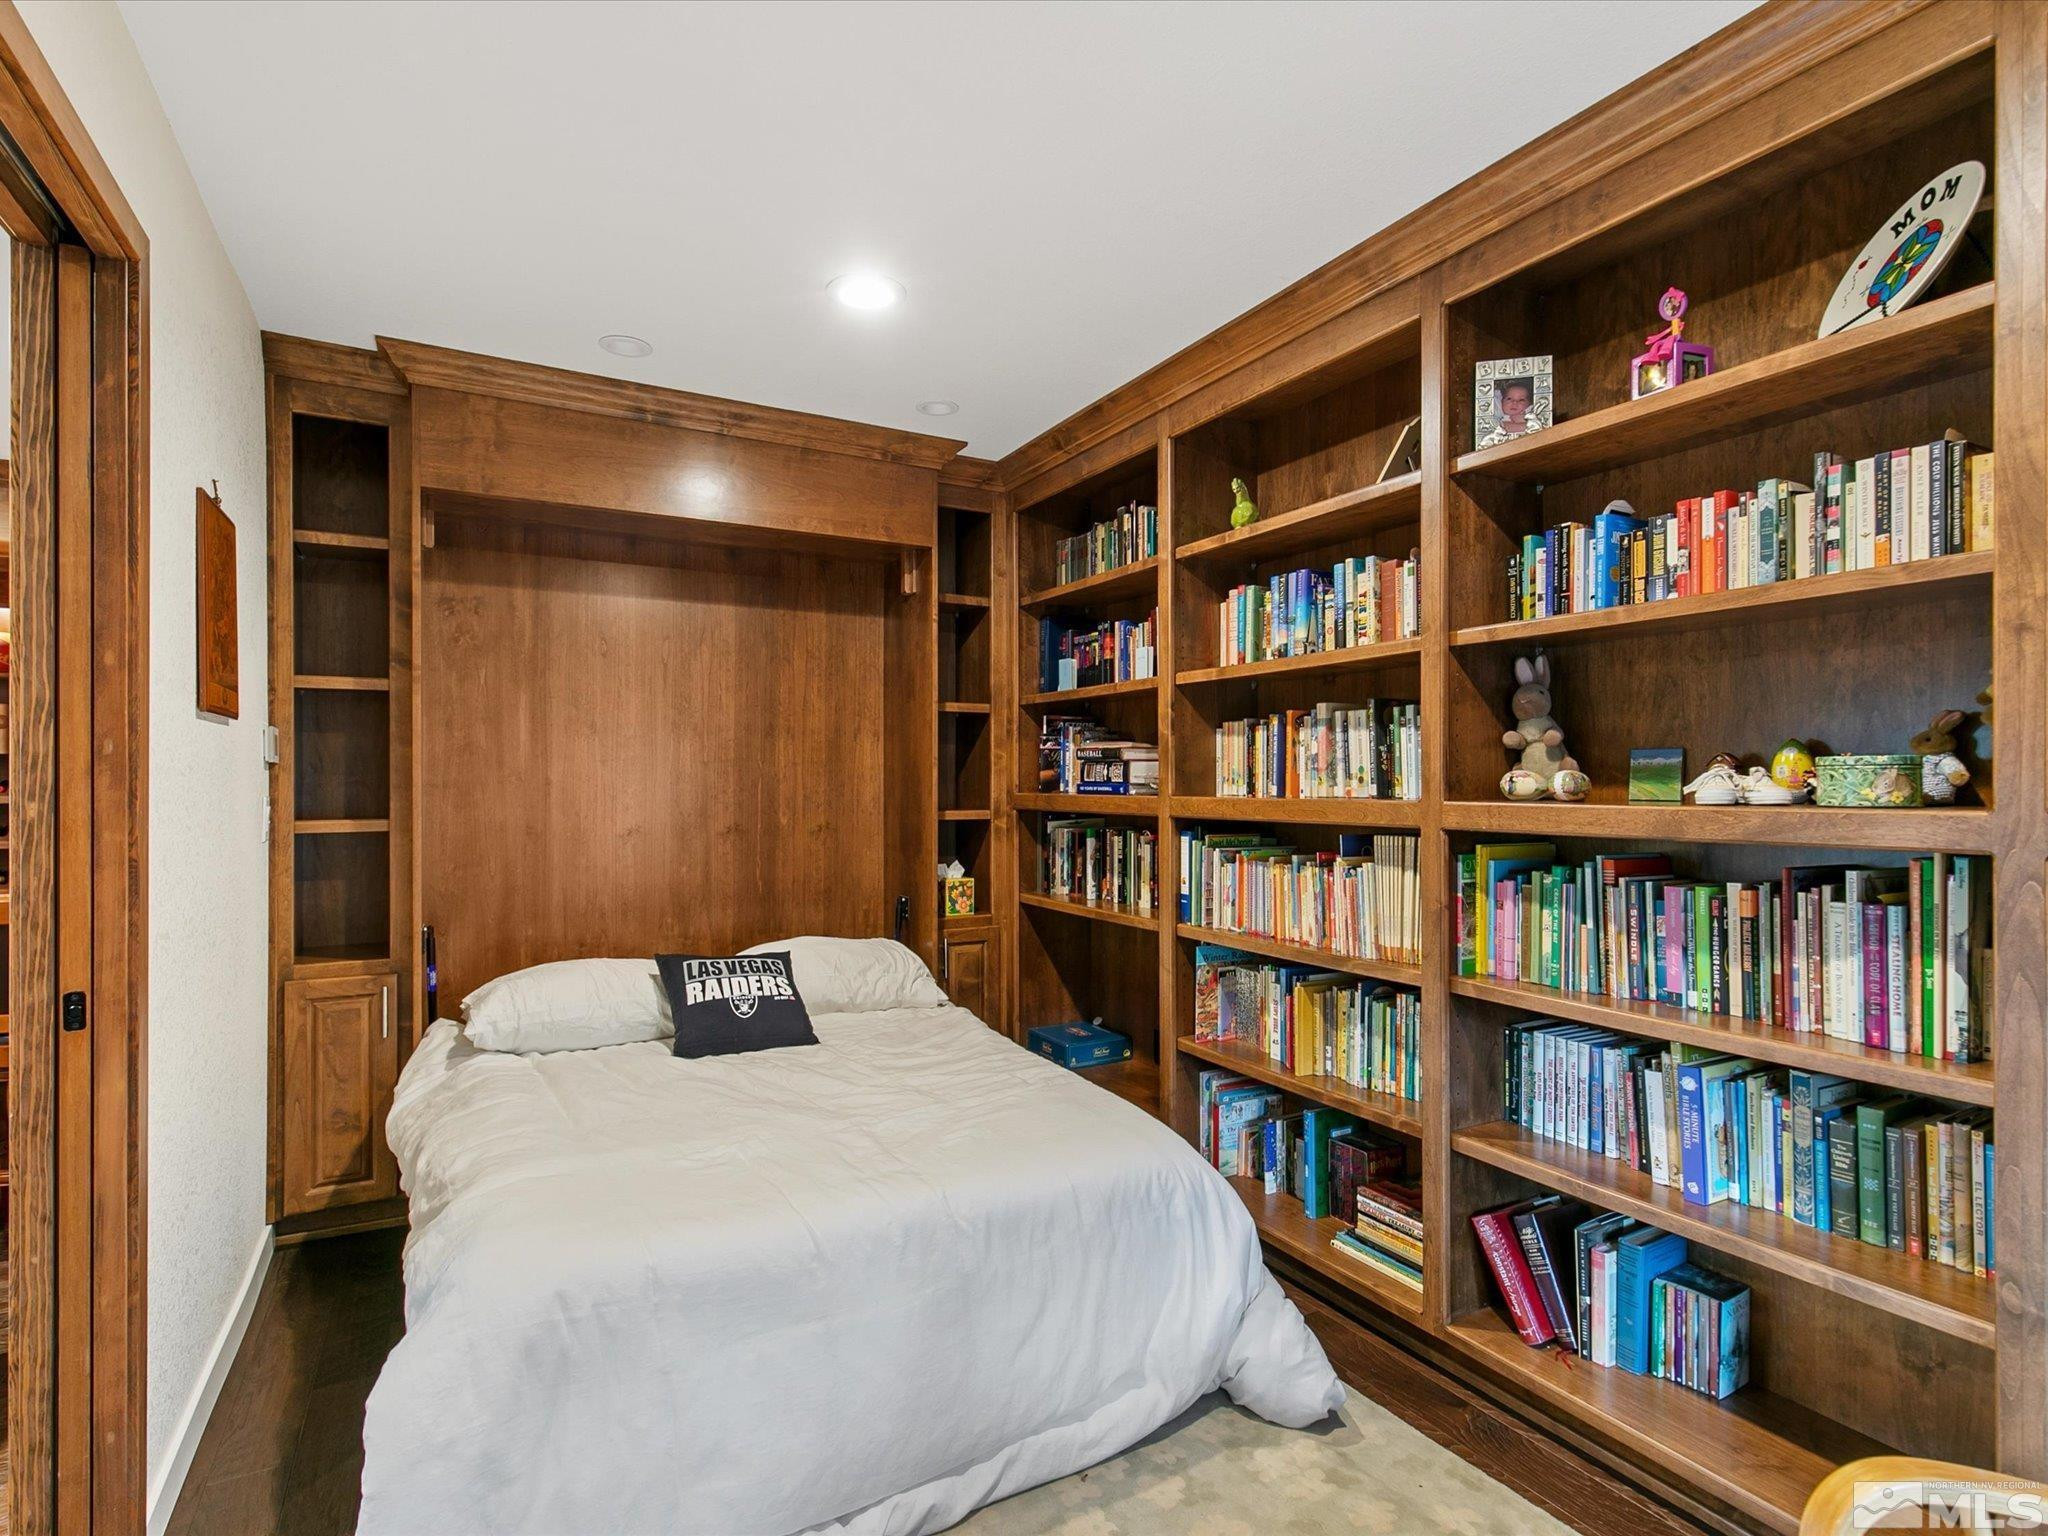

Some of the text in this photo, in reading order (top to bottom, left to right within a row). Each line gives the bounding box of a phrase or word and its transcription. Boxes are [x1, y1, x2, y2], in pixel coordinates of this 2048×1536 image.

[1890, 175, 1962, 239] MOM
[1479, 357, 1549, 377] BABY
[1932, 444, 1941, 556] THE COLD MILLIONS JESS WALTE
[1077, 749, 1103, 758] BASEBALL
[1630, 908, 1639, 961] SWINDLE
[686, 960, 784, 980] LAS VEGAS
[1892, 935, 1902, 981] STEALING
[686, 976, 793, 1006] RAIDERS
[1892, 984, 1902, 1017] HOME
[1664, 1063, 1674, 1099] Secrets
[1682, 1095, 1692, 1149] BIBLE STORIES
[1691, 1104, 1700, 1144] 5-MINUTE
[1974, 1181, 1984, 1237] EL LECTOR
[1492, 1253, 1511, 1286] constant
